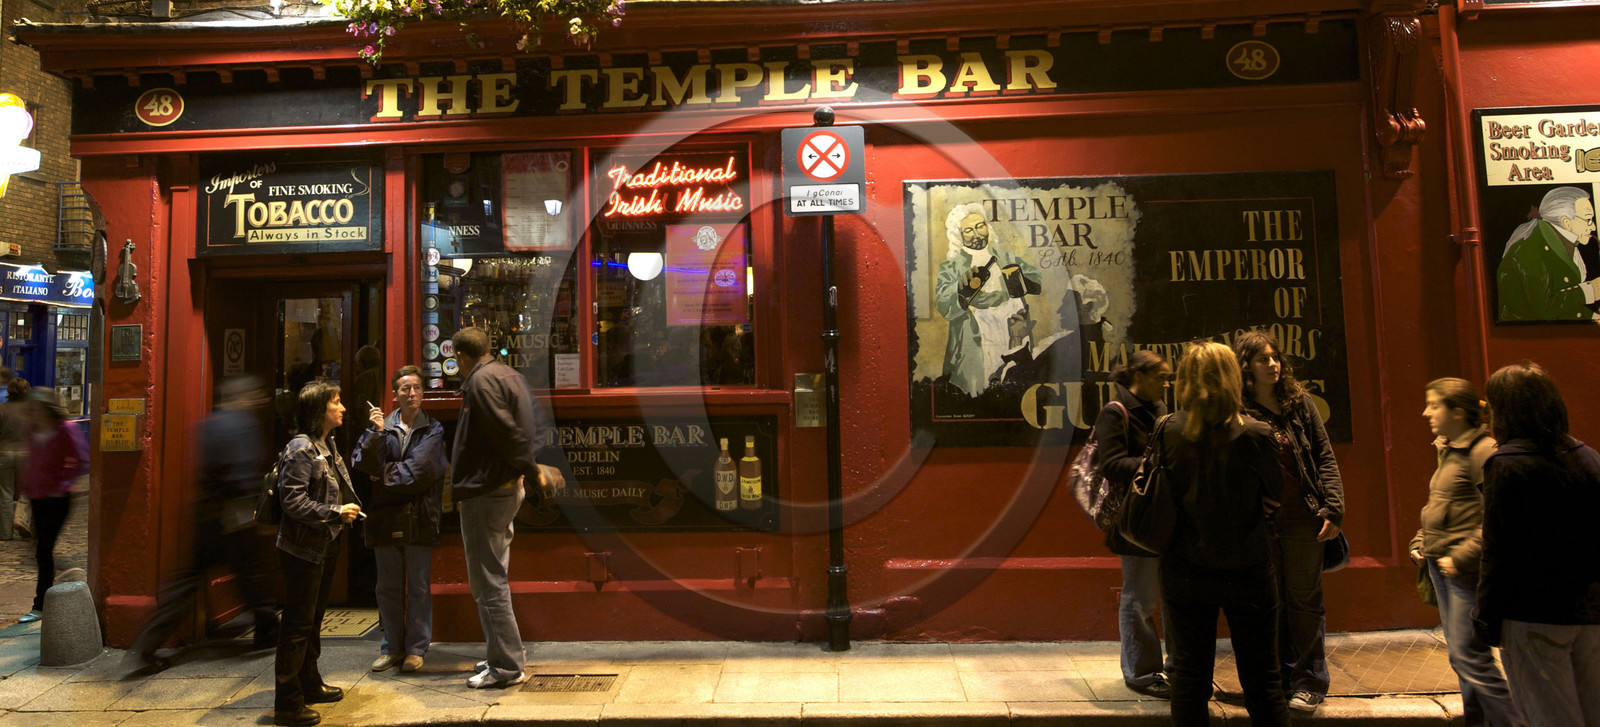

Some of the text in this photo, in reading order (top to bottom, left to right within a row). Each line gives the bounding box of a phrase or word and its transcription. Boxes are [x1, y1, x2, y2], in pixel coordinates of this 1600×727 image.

[1233, 47, 1267, 71] 48
[363, 49, 1058, 120] THE TEMPLE BAR
[143, 94, 174, 117] 48
[1487, 120, 1532, 139] Beer
[1489, 140, 1572, 162] Smoking
[205, 161, 277, 195] Importers
[608, 156, 737, 190] Traditional
[1507, 162, 1555, 181] Area
[250, 180, 263, 189] OF
[268, 183, 353, 197] FINE SMOKING
[604, 186, 743, 218] Irish Music
[796, 197, 854, 208] AT ALL TIMES
[982, 195, 1129, 223] TEMPLE
[223, 192, 355, 239] TOBACCO
[606, 220, 658, 231] GUINNESS
[1243, 209, 1303, 242] THE
[250, 227, 365, 241] Always in Stock
[1028, 222, 1099, 250] BAR
[1088, 250, 1126, 267] 1840
[1168, 247, 1306, 282] EMPEROR
[6, 270, 55, 284] RISTORANTE
[12, 285, 48, 296] ITALIANO
[62, 277, 95, 298] Bo
[1273, 286, 1307, 319] OF
[506, 333, 560, 350] MUSIC
[495, 353, 534, 369] AILY
[544, 424, 708, 447] TEMPLE BAR
[568, 451, 621, 463] DUBLIN
[573, 466, 616, 476] EST. 1840
[573, 488, 609, 499] MUSIC
[611, 487, 646, 498] DAILY
